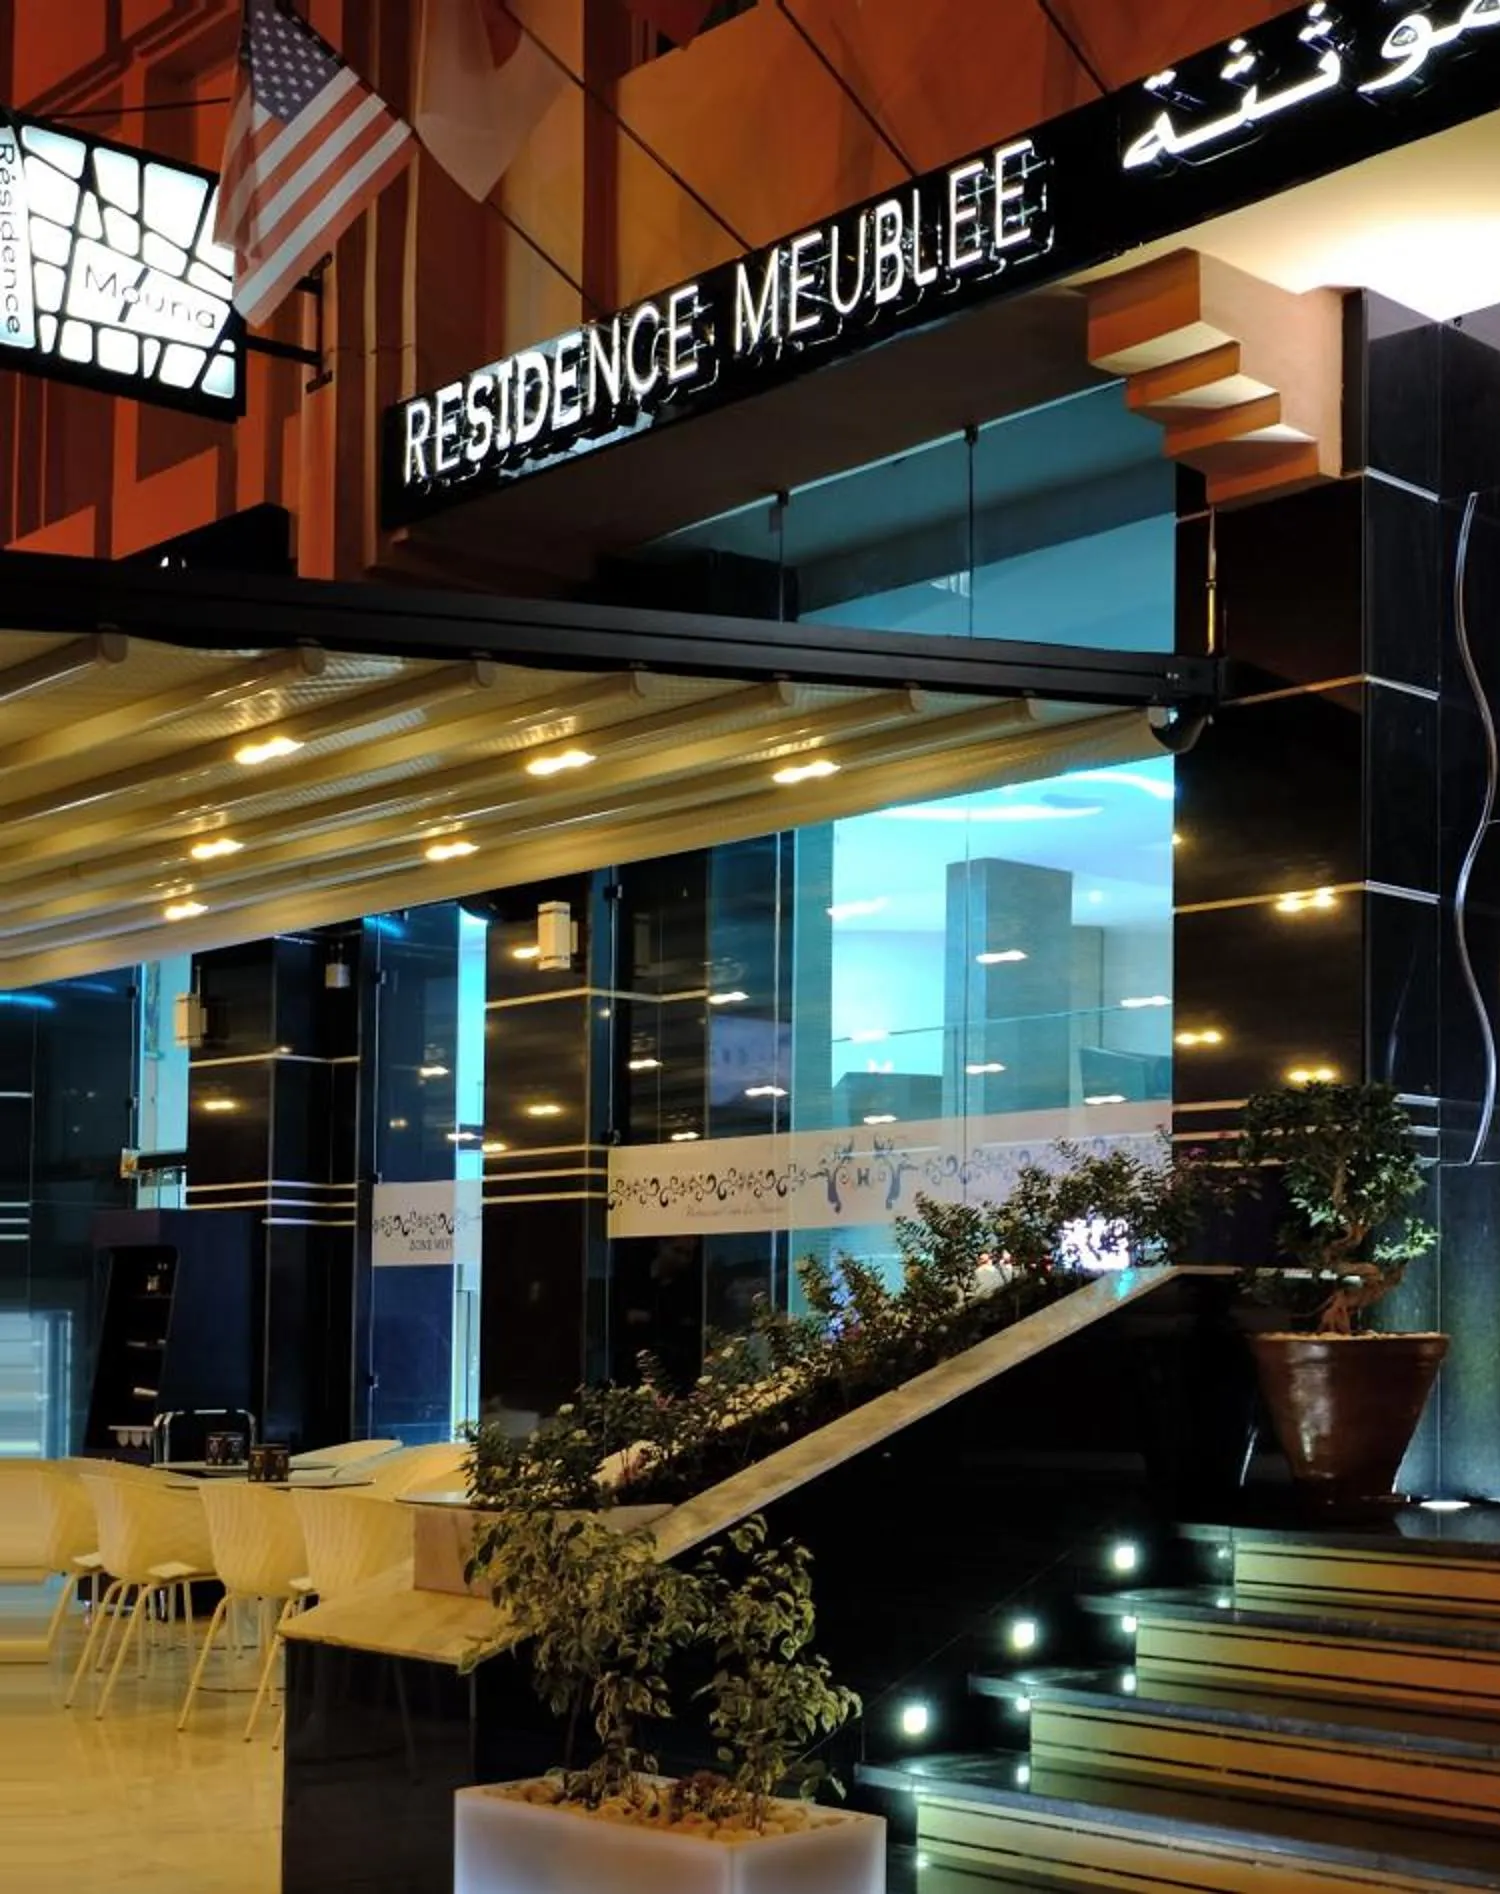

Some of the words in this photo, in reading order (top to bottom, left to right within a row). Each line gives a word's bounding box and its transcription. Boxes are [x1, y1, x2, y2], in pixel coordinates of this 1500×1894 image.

[84, 264, 216, 331] Mouna
[404, 285, 699, 484] RESIDENCE
[734, 139, 1033, 353] MEUBLEE
